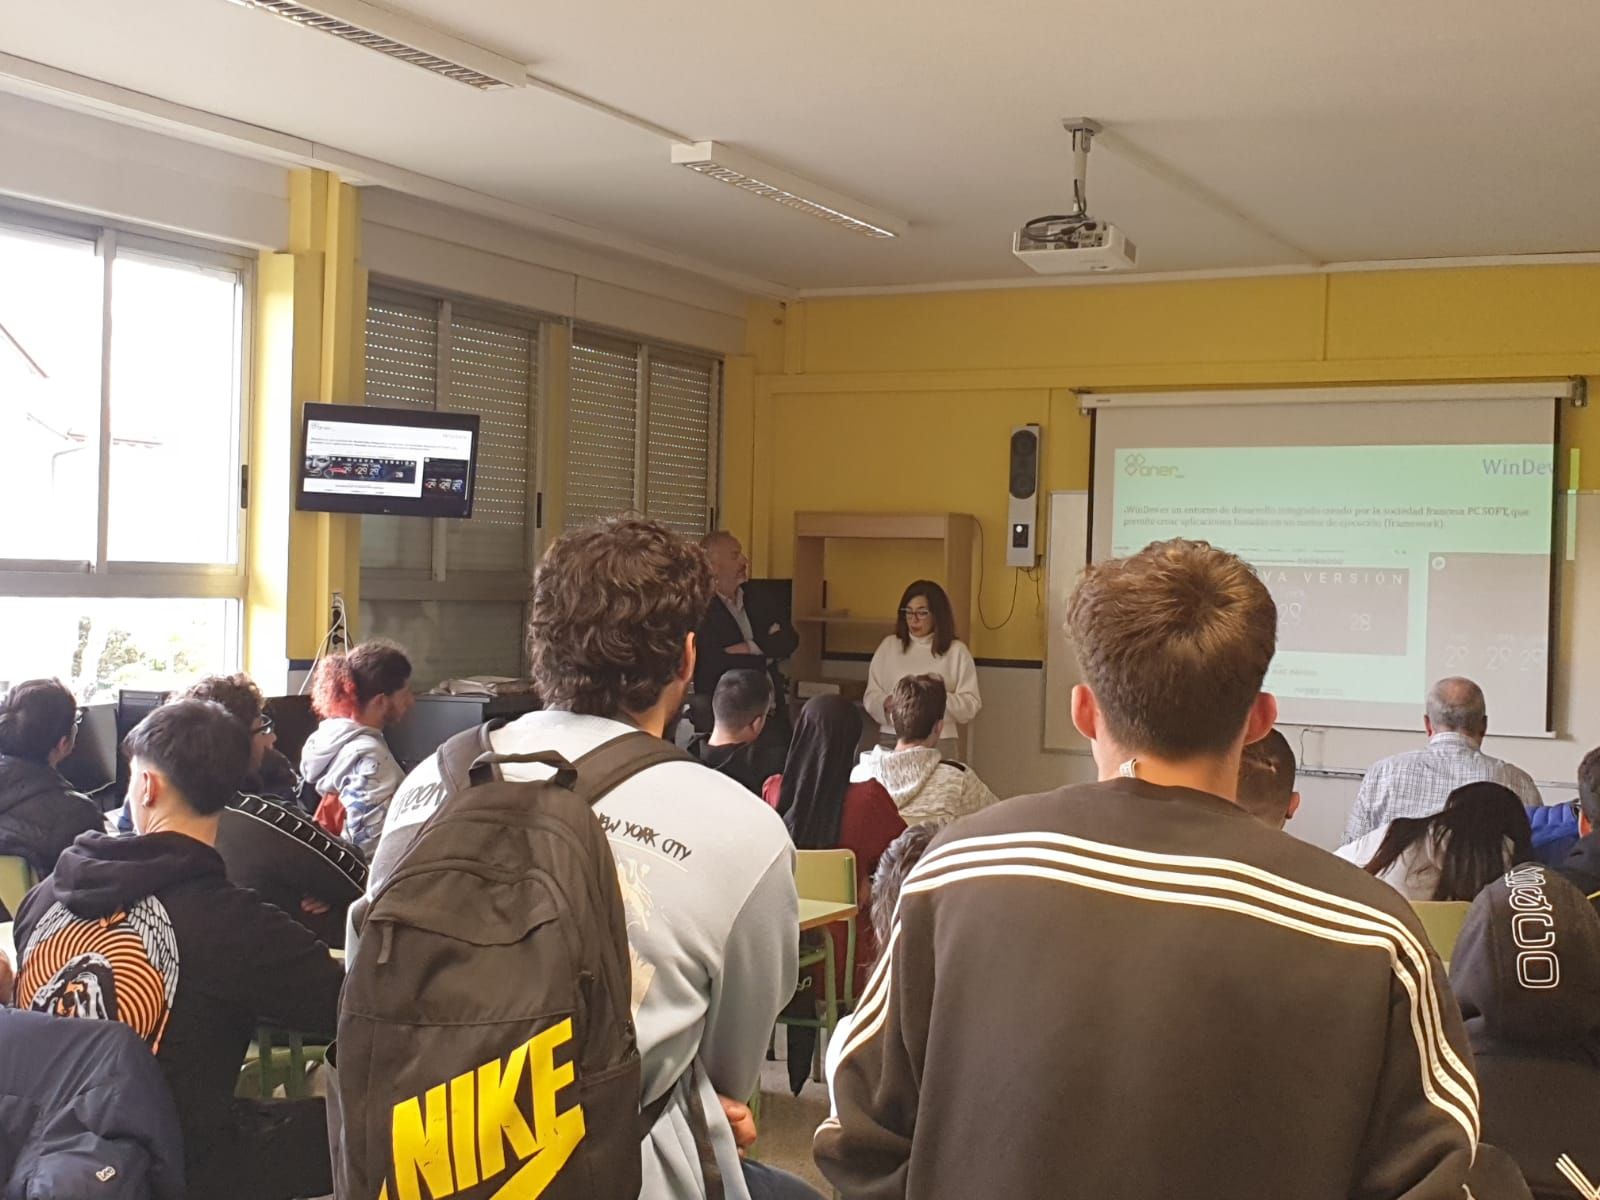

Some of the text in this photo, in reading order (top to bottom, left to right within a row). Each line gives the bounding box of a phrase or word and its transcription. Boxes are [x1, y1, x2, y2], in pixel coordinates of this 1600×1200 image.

[1303, 571, 1402, 585] VERSIÓN
[623, 821, 660, 848] YORK
[392, 1016, 585, 1200] NIKE
